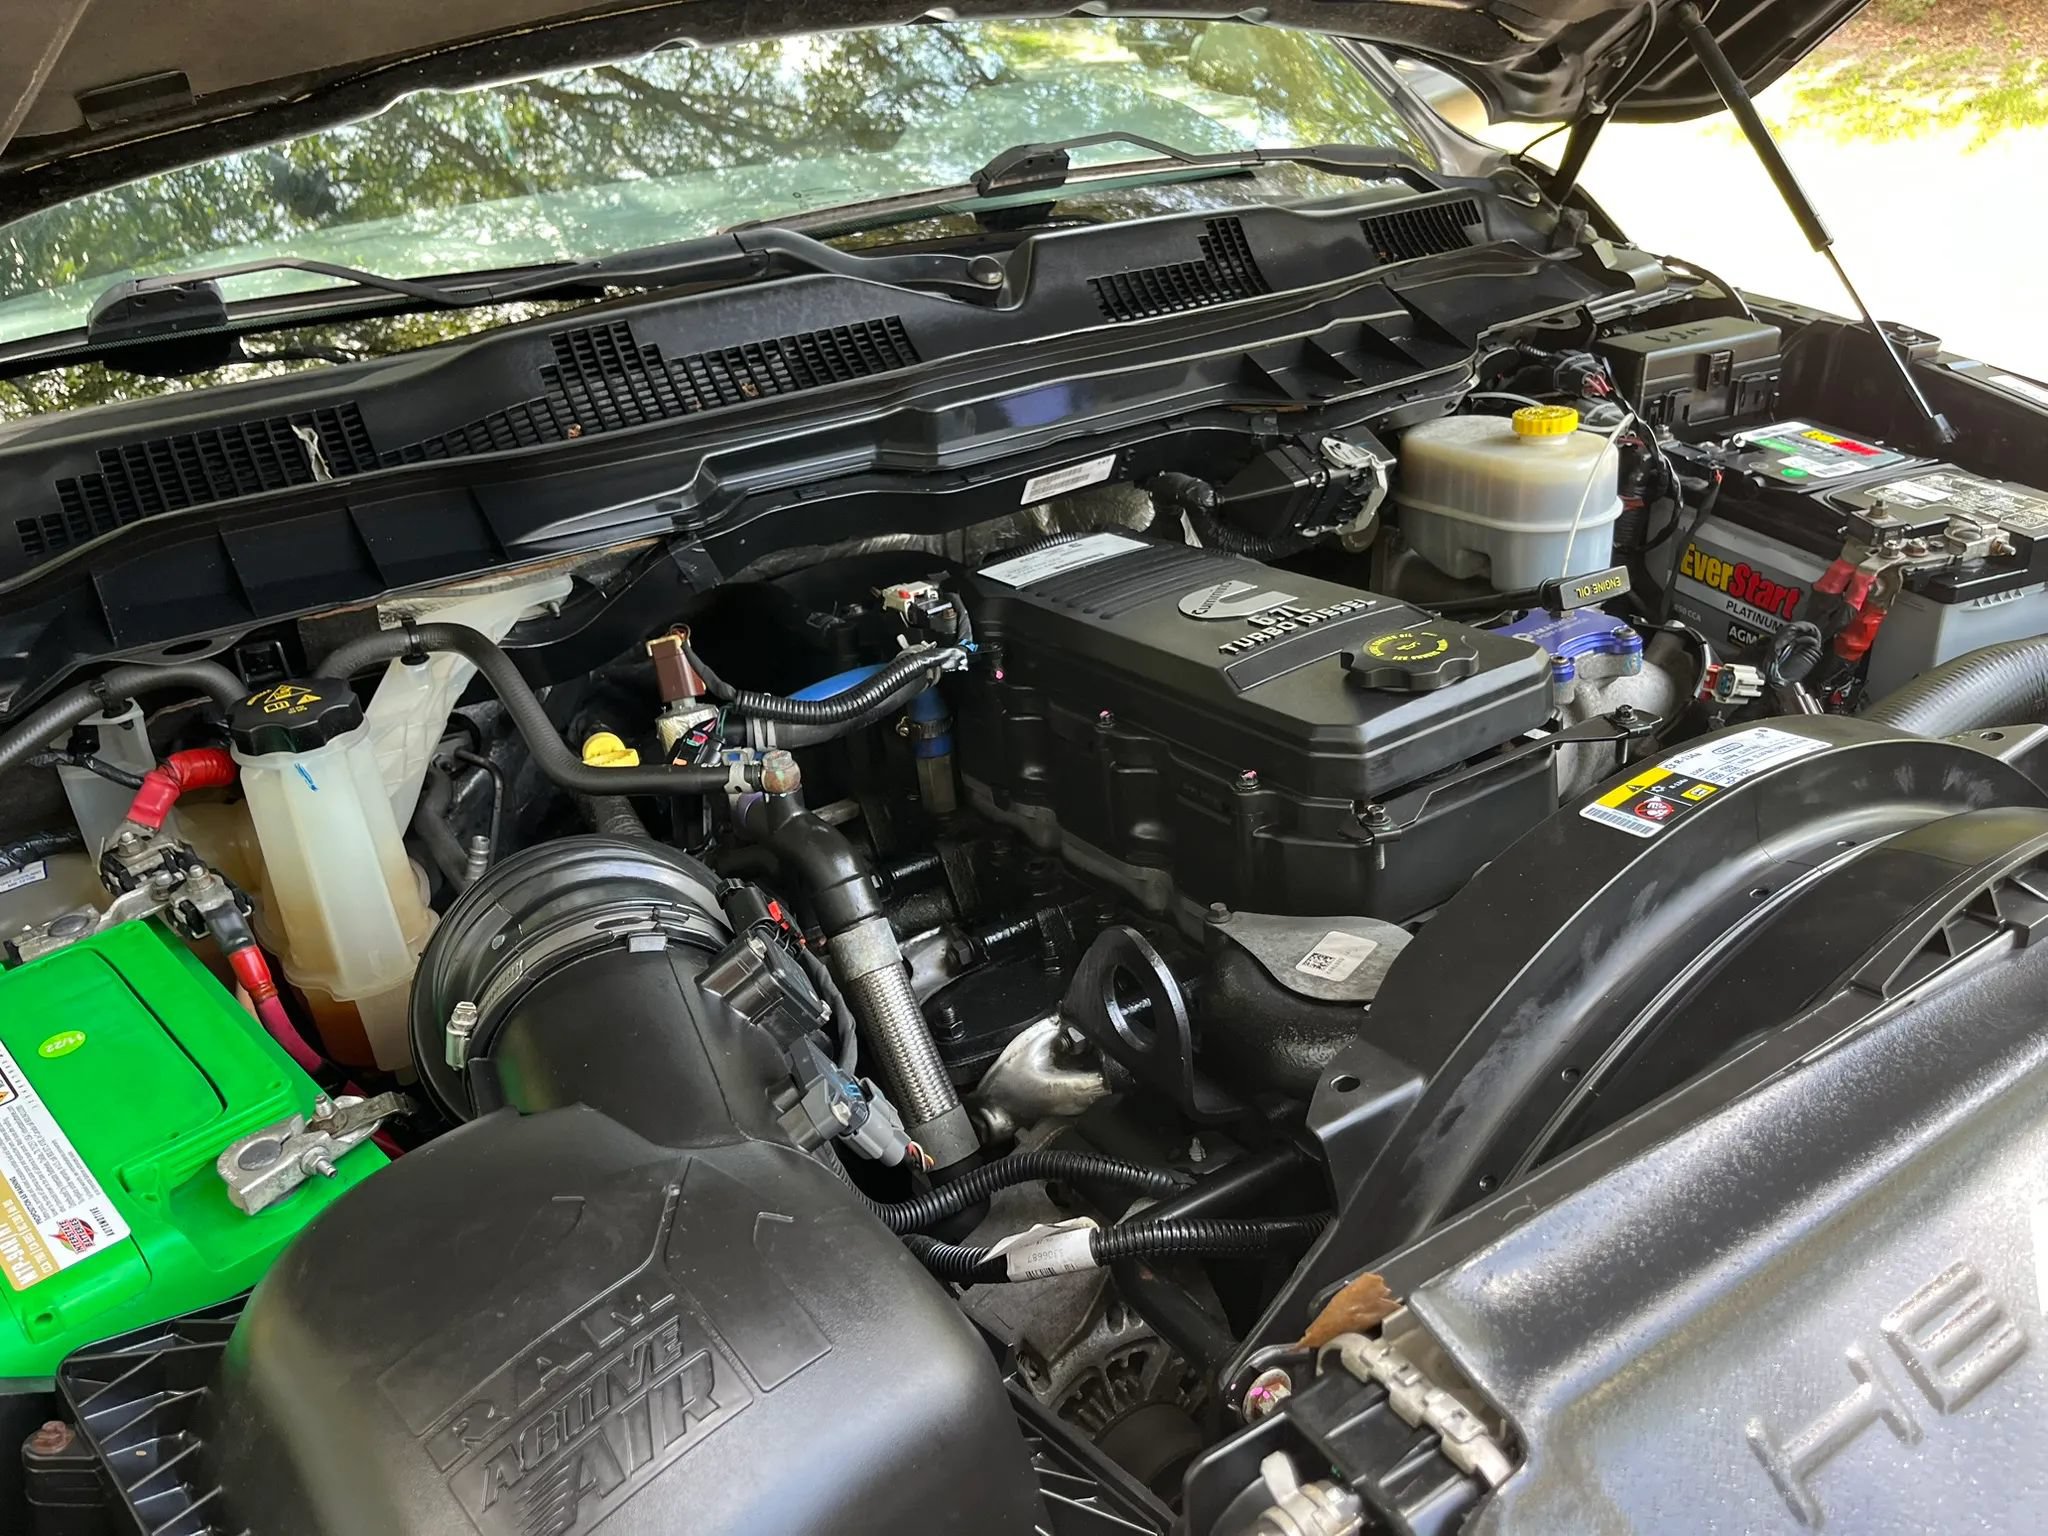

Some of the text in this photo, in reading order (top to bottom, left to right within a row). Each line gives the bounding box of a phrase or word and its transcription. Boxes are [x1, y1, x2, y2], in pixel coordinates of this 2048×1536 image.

[1576, 576, 1621, 599] ENGINE OIL
[1680, 543, 1801, 620] EverStart
[1219, 598, 1377, 655] TURBO DIESEL
[1248, 604, 1312, 628] 6.7L
[1728, 625, 1758, 645] AGM
[57, 1219, 85, 1254] INTERSTATE
[69, 1217, 95, 1248] BATTERIES
[90, 1207, 115, 1237] AUTOMOTIVE
[424, 1292, 676, 1475] RAM
[480, 1314, 684, 1514] ACTIVE
[535, 1348, 721, 1536] AIR
